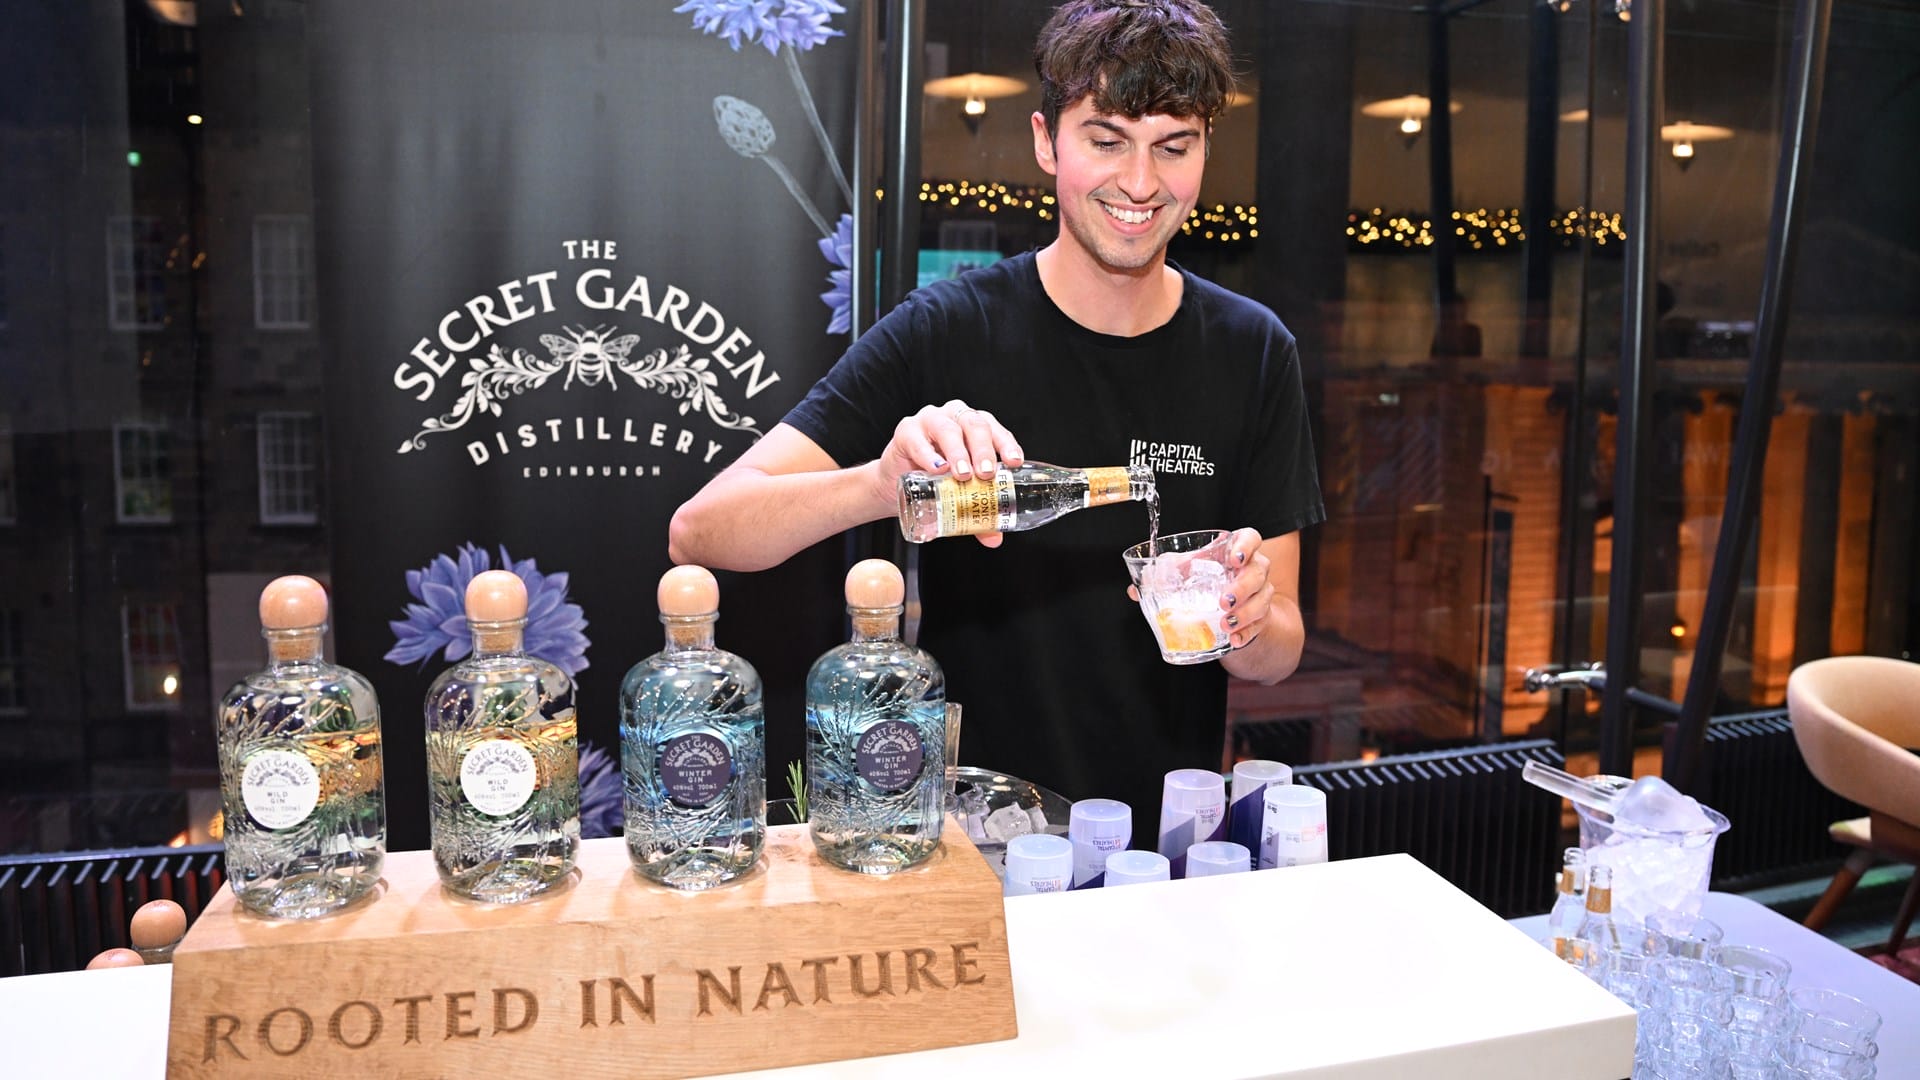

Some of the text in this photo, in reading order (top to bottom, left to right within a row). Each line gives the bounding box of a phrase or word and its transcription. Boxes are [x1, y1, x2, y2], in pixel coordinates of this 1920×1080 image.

[562, 240, 617, 260] THE
[394, 269, 781, 401] SECRET GARDEN
[466, 417, 723, 465] DISTILLERY
[1149, 443, 1204, 460] CAPITAL
[523, 465, 661, 478] EDINBURGH
[1148, 458, 1215, 476] THEATRES
[971, 492, 980, 525] WATER
[981, 492, 990, 523] TONIC
[665, 740, 726, 767] SECRET GARDEN
[862, 727, 918, 754] SECRET GARDEN
[248, 760, 311, 786] SECRET GARDEN
[467, 749, 492, 775] SECRET
[495, 748, 528, 773] GARDEN
[202, 942, 986, 1064] ROOTED IN NATURE
